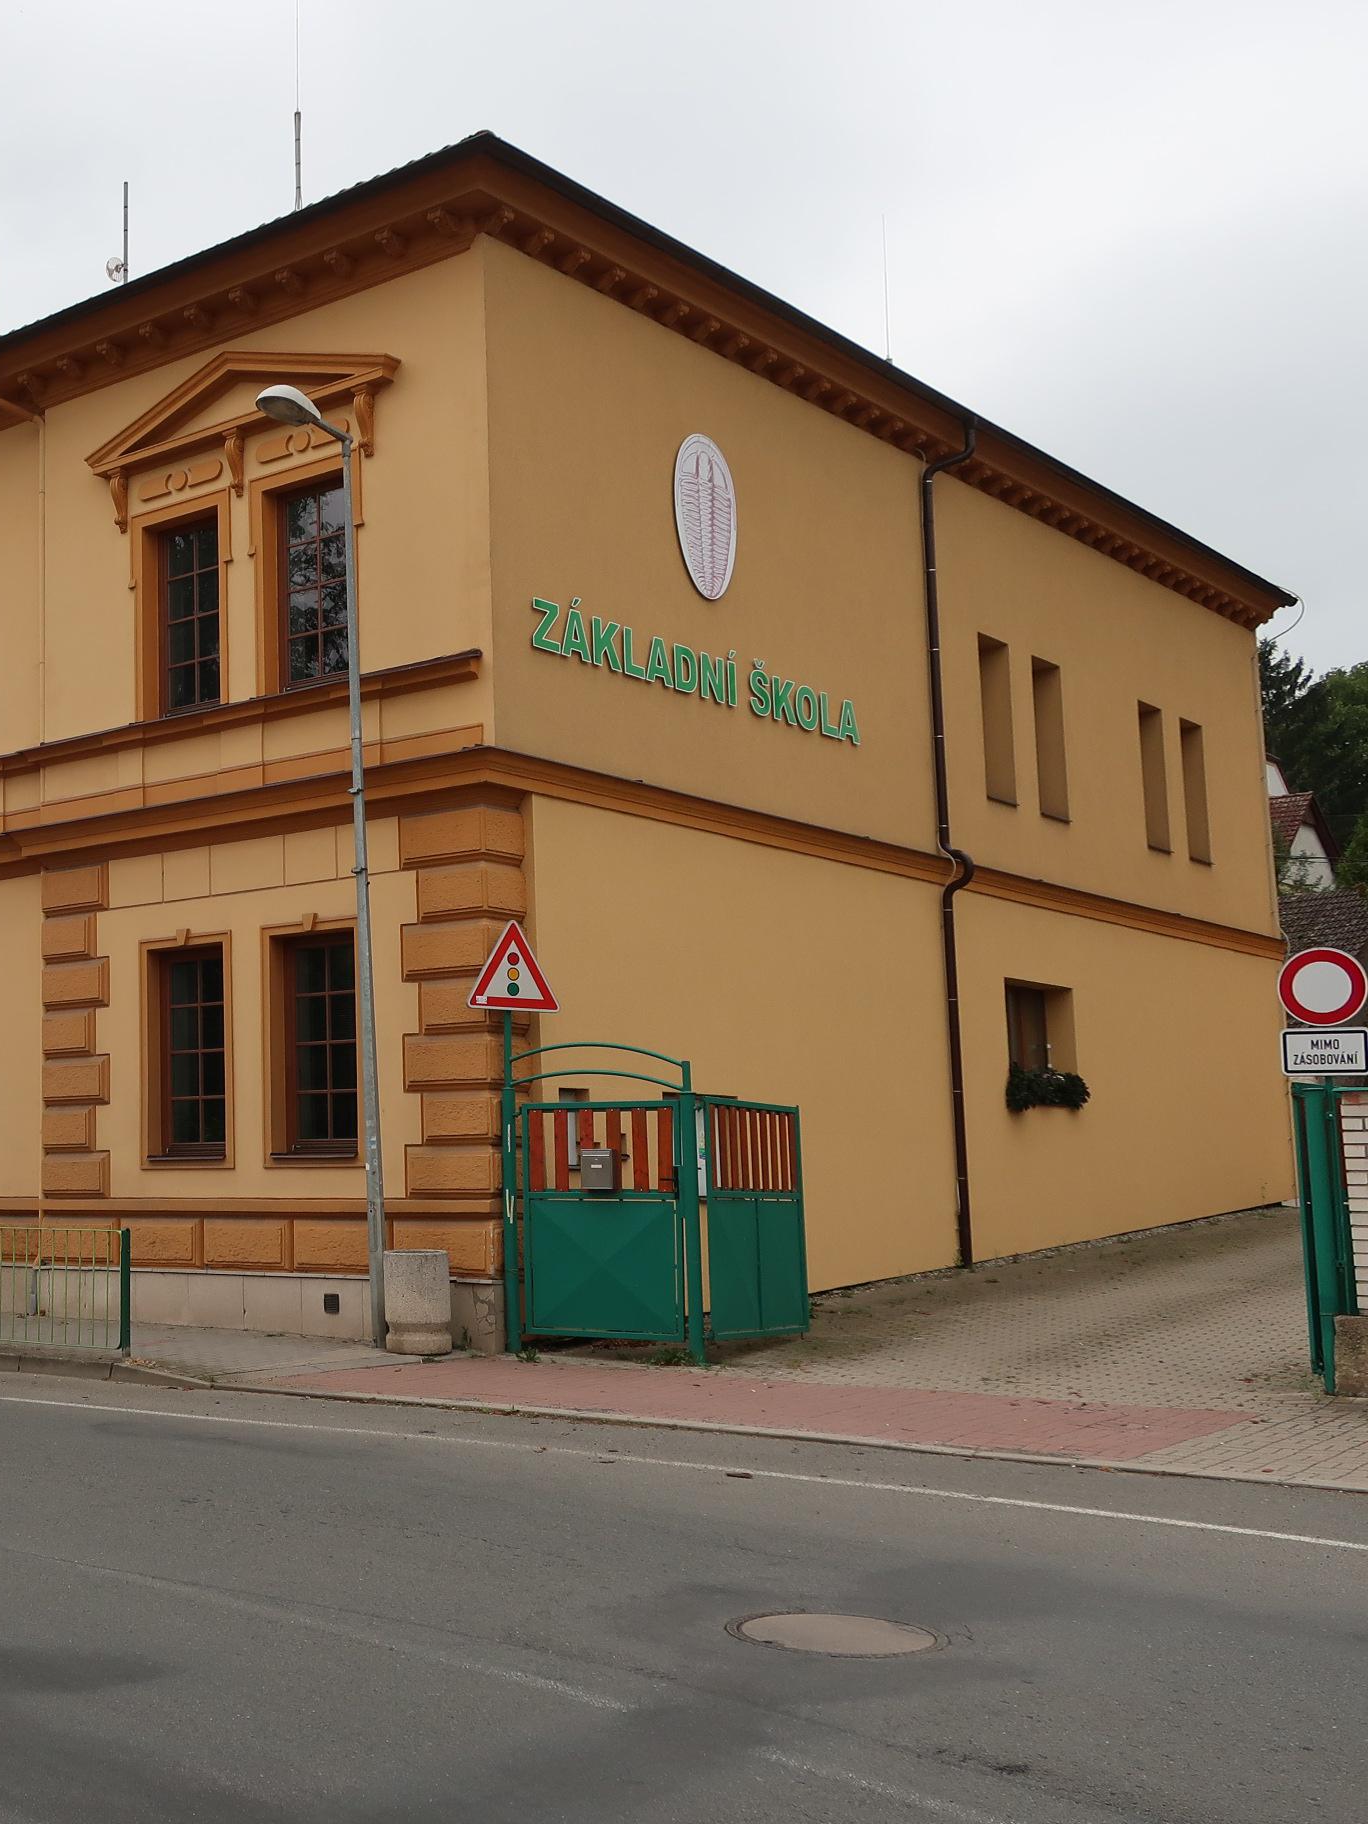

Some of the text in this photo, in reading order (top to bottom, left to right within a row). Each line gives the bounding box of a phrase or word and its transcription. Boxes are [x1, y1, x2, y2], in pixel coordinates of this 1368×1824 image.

[532, 596, 861, 745] ZÁKLADNÍ ŠKOLA
[1310, 1038, 1340, 1050] MIMO
[1293, 1051, 1359, 1065] ZÁSOBOVÁNÍ
